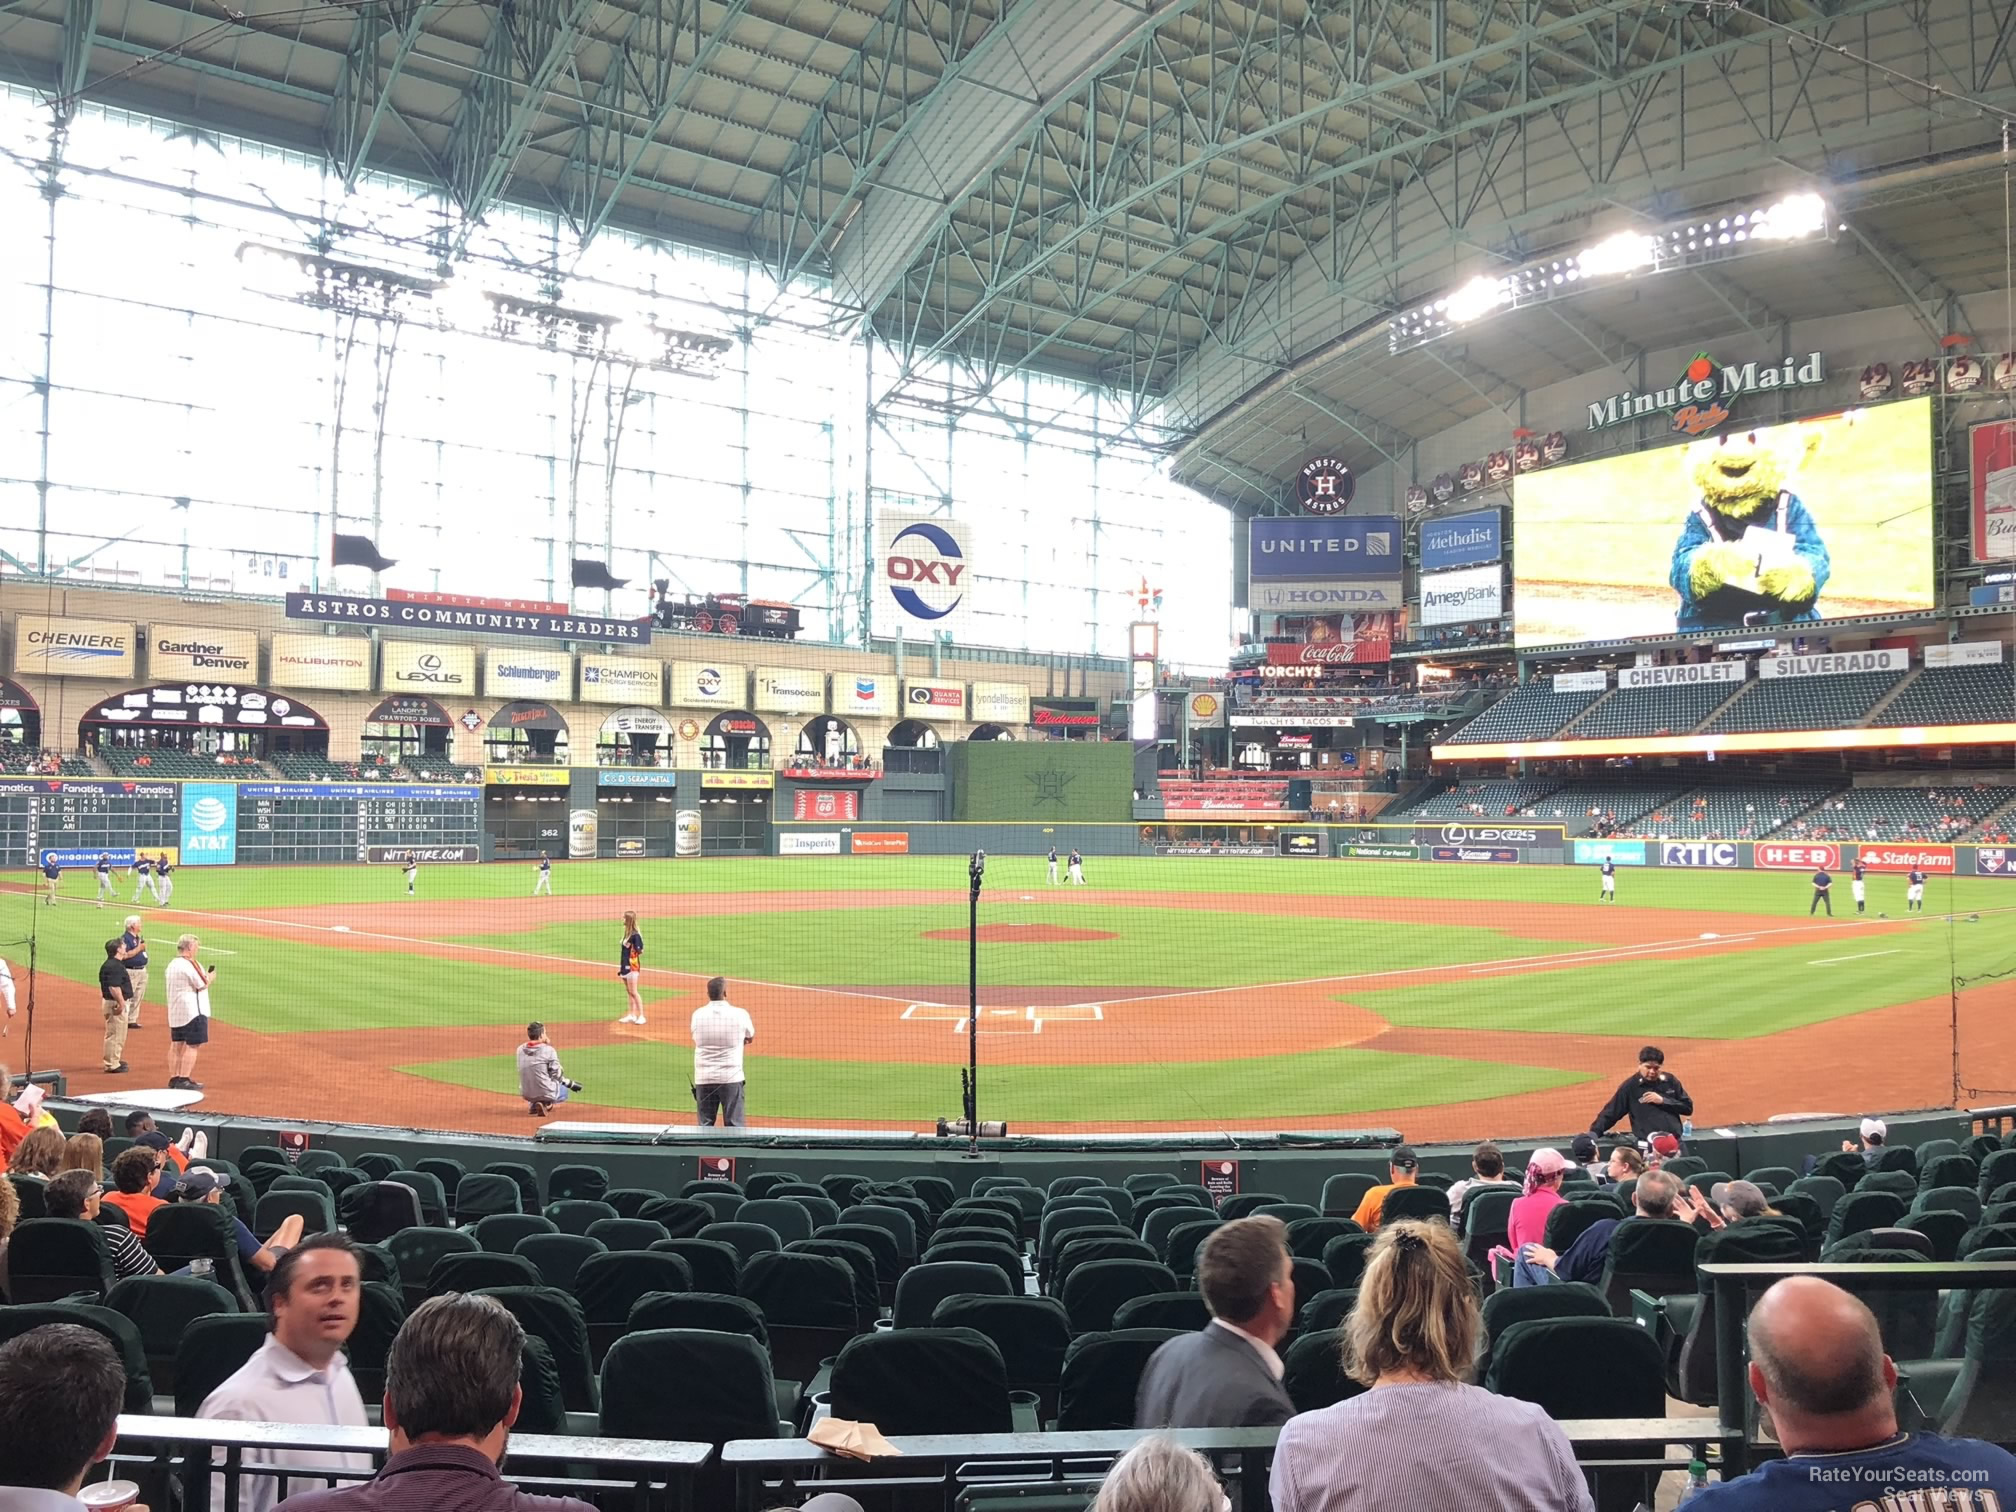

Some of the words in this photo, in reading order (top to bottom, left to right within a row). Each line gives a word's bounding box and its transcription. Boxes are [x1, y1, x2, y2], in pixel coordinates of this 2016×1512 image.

[1903, 358, 1932, 381] 24
[1955, 355, 1969, 377] 5
[1860, 363, 1888, 386] 49
[1587, 377, 1714, 430] Minute
[1720, 352, 1823, 394] Maid
[1673, 403, 1729, 430] Park
[1488, 451, 1505, 468] 33
[1303, 459, 1348, 476] HOUSTON
[1315, 476, 1336, 495] H
[1305, 497, 1345, 511] ASTROS
[1261, 539, 1359, 553] UNITED
[1428, 528, 1492, 550] Methodist
[887, 556, 965, 586] OXY
[407, 592, 485, 606] MINUTE
[504, 601, 552, 611] MAID
[1288, 589, 1388, 602] HONDA
[1424, 585, 1497, 607] AmegyBank
[301, 599, 390, 618] ASTROS
[401, 607, 540, 630] COMMUNITY
[550, 619, 639, 638] LEADERS
[28, 631, 125, 648] CHENIERE
[158, 640, 223, 655] Gardner
[1300, 643, 1358, 663] Coca-Cola
[193, 655, 249, 669] Denver
[279, 656, 363, 667] HALLIBURTON
[1776, 652, 1891, 675] SILVERADO
[396, 671, 462, 683] LEXUS
[497, 665, 561, 682] Schlumberger
[600, 669, 658, 680] CHAMPION
[1630, 664, 1733, 685] CHEVROLET
[697, 678, 721, 686] OXY
[771, 686, 821, 697] Transocean
[976, 692, 1027, 706] lyondellbasell
[392, 706, 428, 715] LANDRY'S
[1034, 711, 1100, 725] Budweiser
[1302, 717, 1332, 725] TACOS
[604, 774, 610, 782] C
[619, 774, 625, 782] D
[627, 775, 648, 783] SCRAP
[649, 775, 670, 783] METAL
[63, 784, 103, 793] Fanatics
[135, 785, 174, 794] Fanatics
[819, 803, 832, 811] 66
[1201, 800, 1244, 809] Budweiser
[541, 829, 559, 837] 362
[187, 836, 230, 849] AT&T
[795, 839, 837, 850] Insperity
[1356, 847, 1381, 856] National
[1663, 843, 1734, 865] RTIC
[1767, 850, 1826, 861] H-E-B
